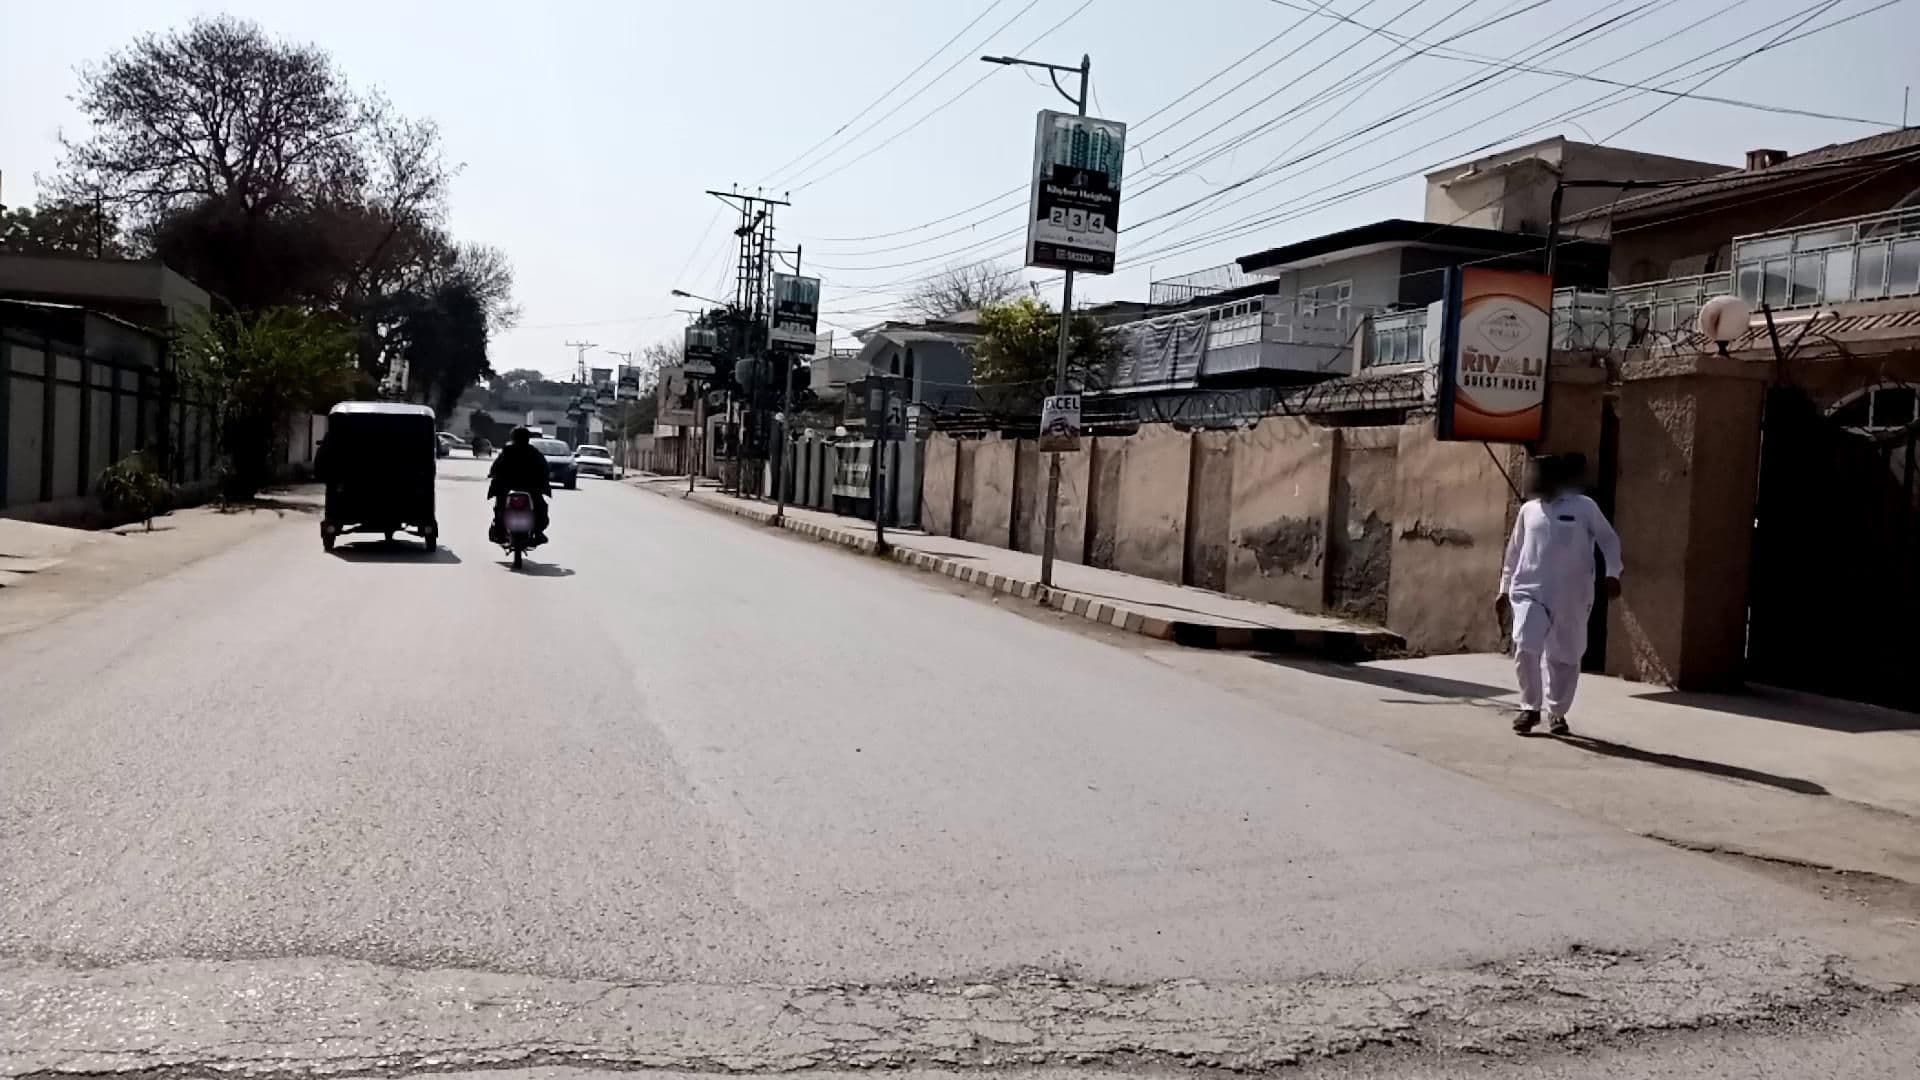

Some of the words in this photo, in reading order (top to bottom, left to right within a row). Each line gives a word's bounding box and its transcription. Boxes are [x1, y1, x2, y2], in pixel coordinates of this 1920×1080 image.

[1053, 211, 1062, 223] 2
[1073, 214, 1082, 226] 3
[1093, 217, 1101, 229] 4
[1462, 353, 1542, 377] RIVLI
[1464, 375, 1498, 388] GUEST
[1503, 378, 1537, 391] HOUSE
